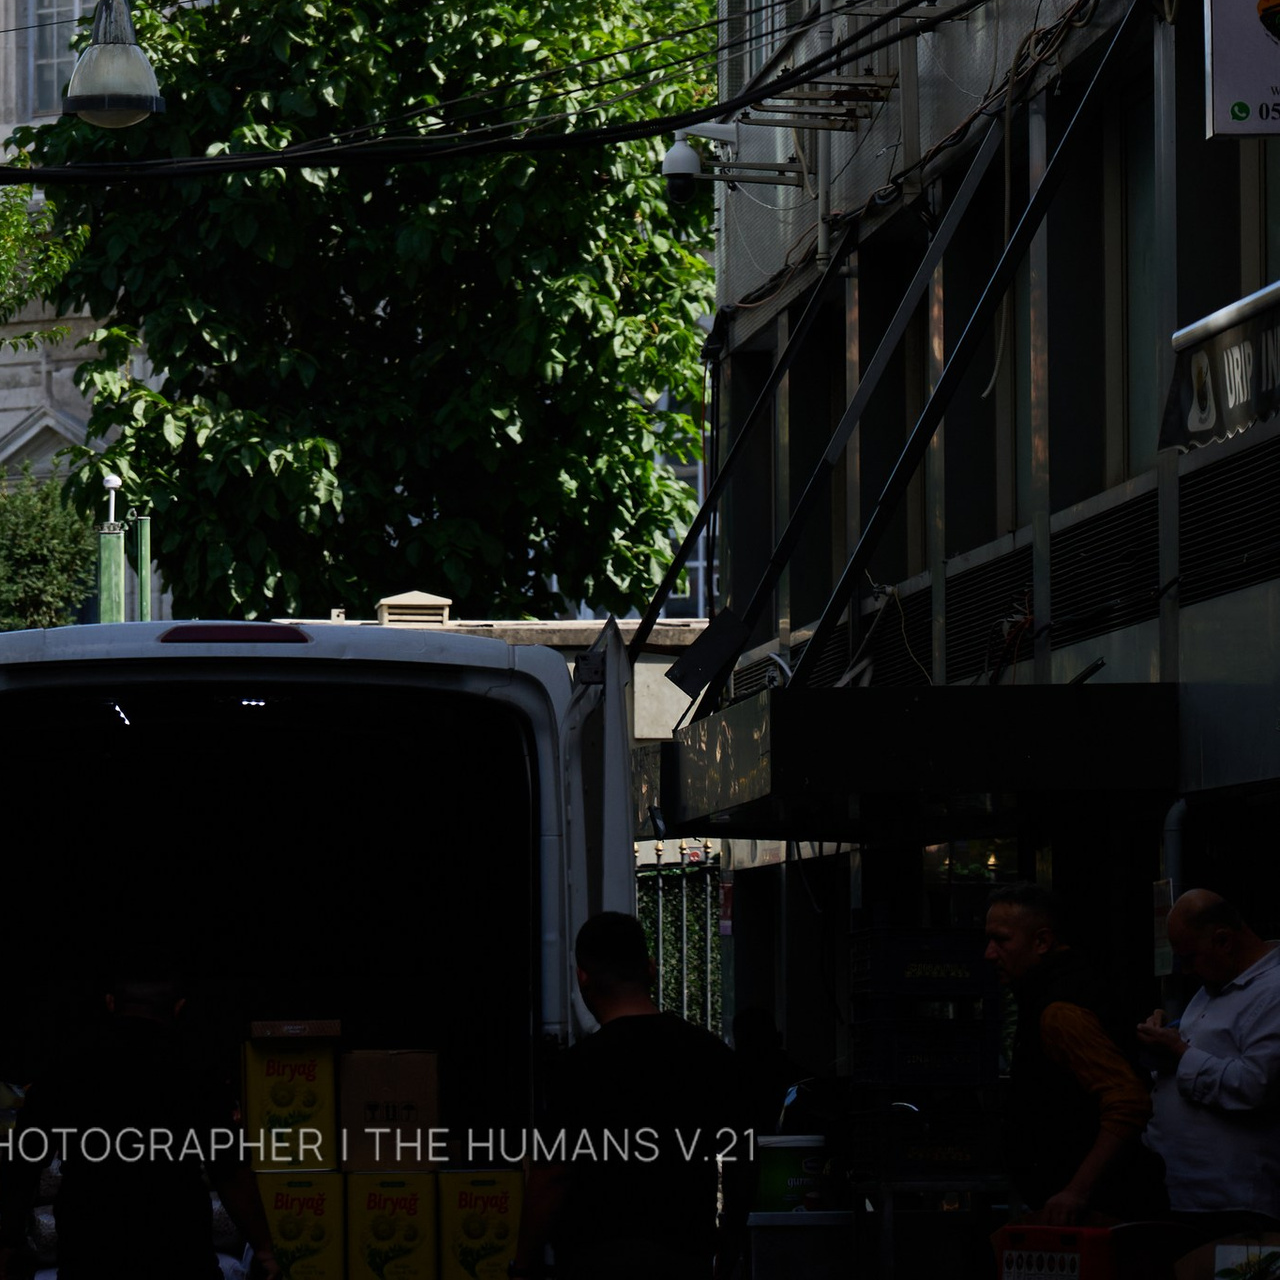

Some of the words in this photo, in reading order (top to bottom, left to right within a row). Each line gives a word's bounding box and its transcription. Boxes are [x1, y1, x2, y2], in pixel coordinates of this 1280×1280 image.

[266, 1059, 318, 1081] Biryağ
[274, 1192, 326, 1215] Biryağ
[367, 1192, 419, 1215] Biryağ
[458, 1191, 510, 1213] Biryağ
